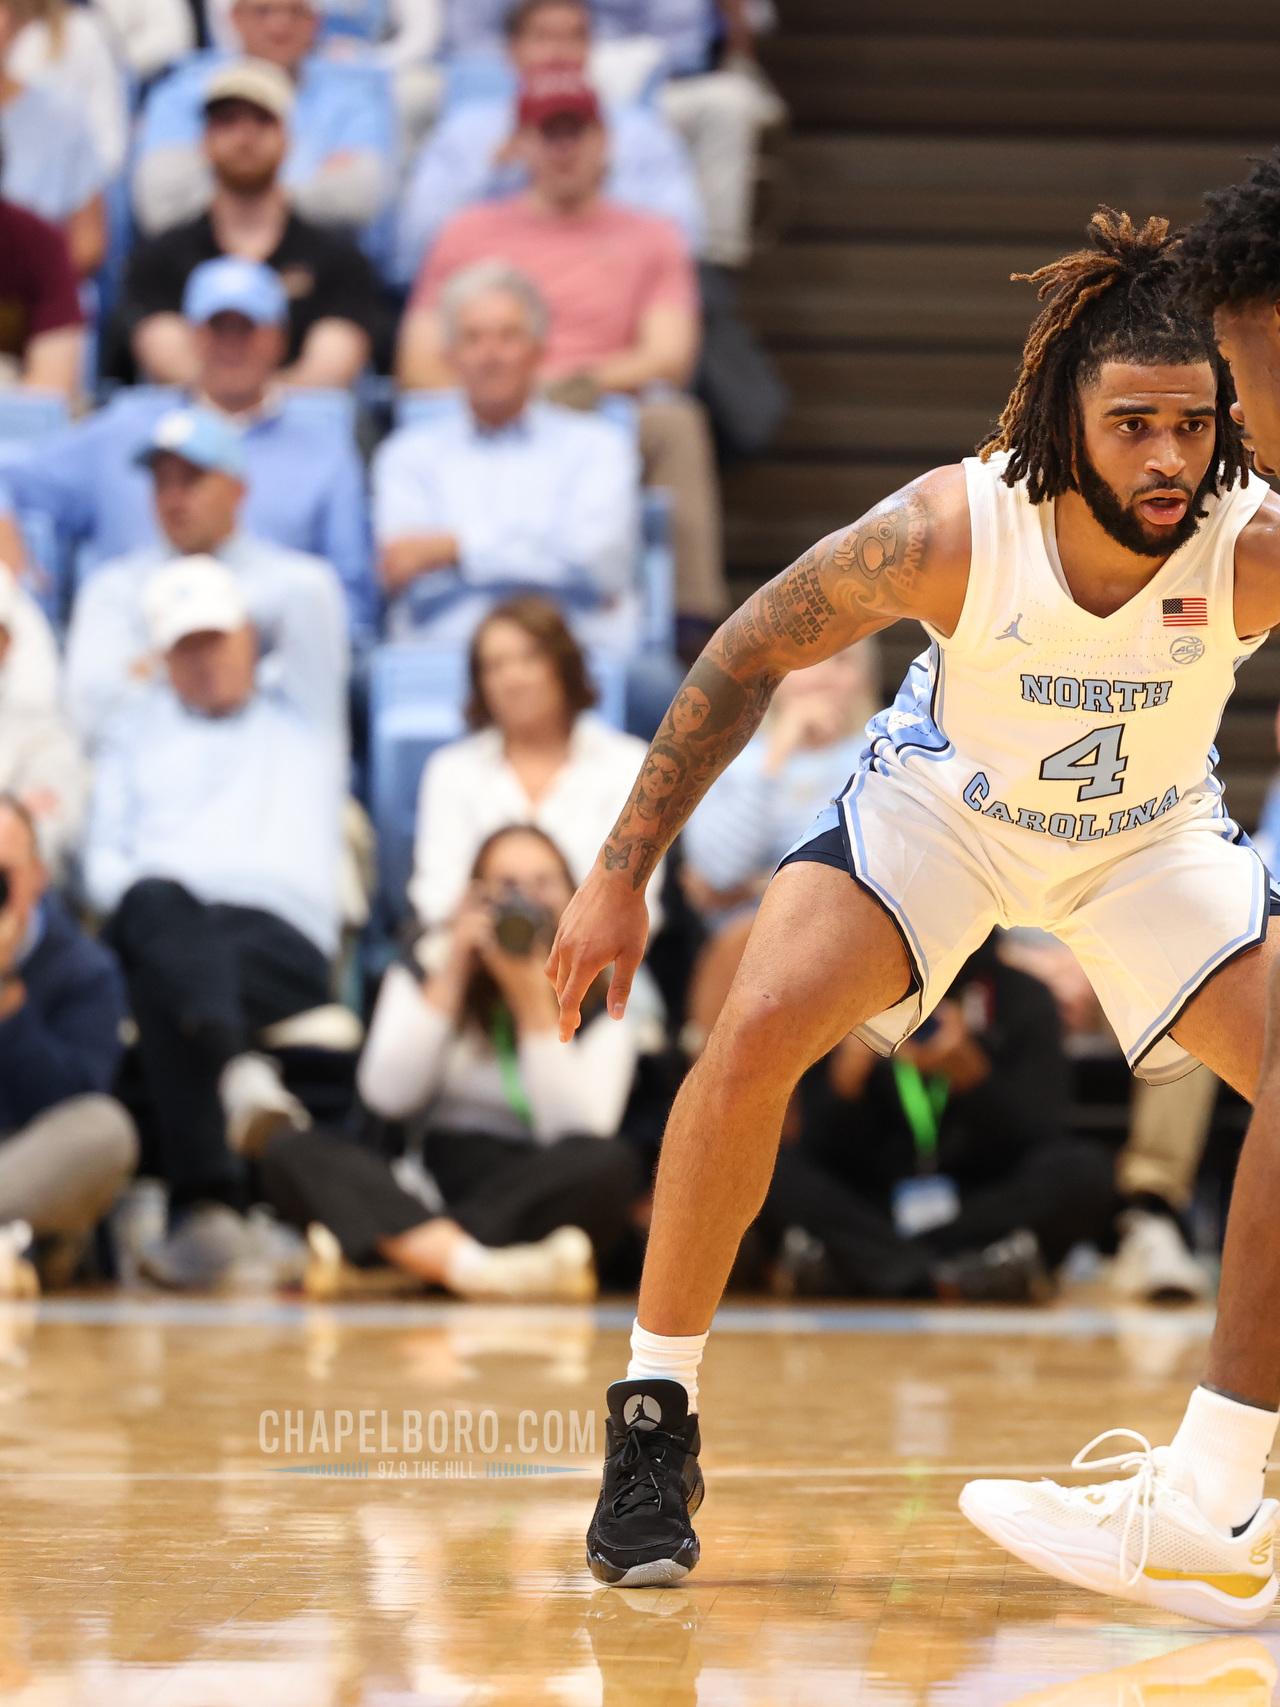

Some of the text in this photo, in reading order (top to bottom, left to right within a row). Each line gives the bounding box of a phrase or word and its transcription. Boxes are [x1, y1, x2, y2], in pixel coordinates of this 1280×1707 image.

[810, 575, 837, 616] KNOW
[1020, 673, 1173, 714] NORTH
[1038, 723, 1129, 802] 4
[963, 772, 1180, 842] CAROLINA
